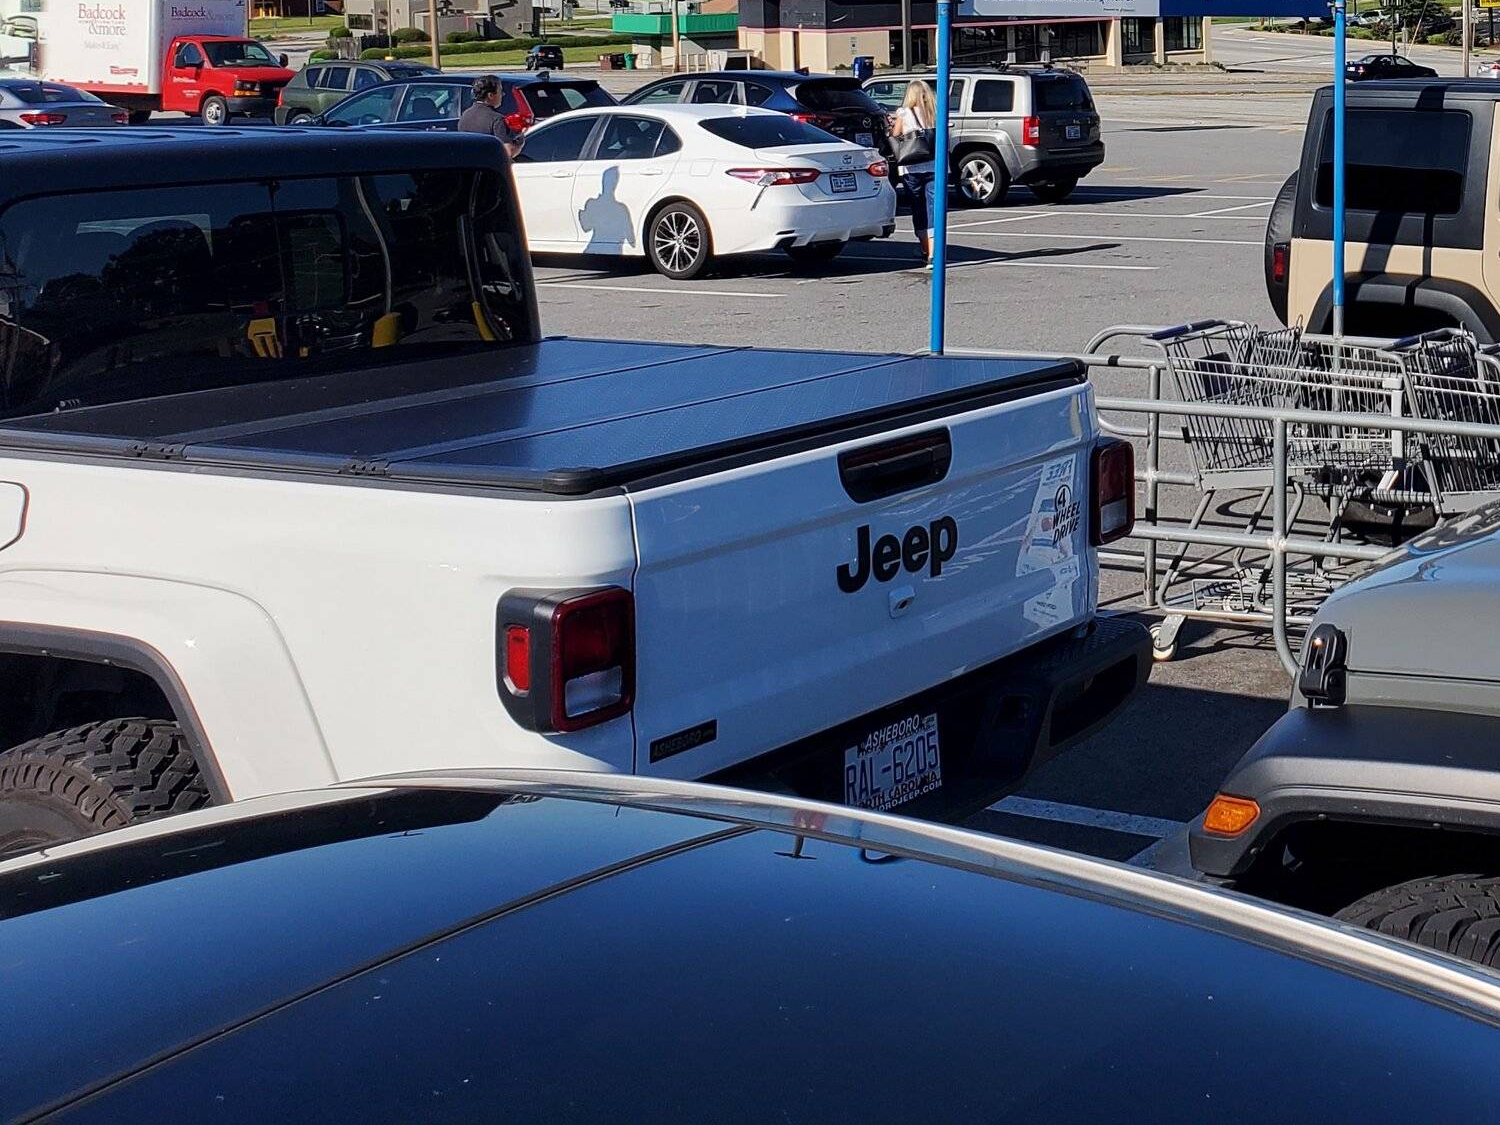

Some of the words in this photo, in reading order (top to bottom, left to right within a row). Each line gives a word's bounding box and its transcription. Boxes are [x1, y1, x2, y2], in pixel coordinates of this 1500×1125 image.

[79, 3, 126, 20] Badcock
[171, 7, 206, 18] Badcock
[89, 19, 127, 36] &more
[1057, 488, 1067, 508] 4
[1052, 501, 1081, 529] WHEEL
[1052, 517, 1080, 546] DRIVE
[836, 516, 958, 594] Jeep
[866, 715, 920, 749] ASHEBORO
[845, 730, 939, 807] RAL-6205
